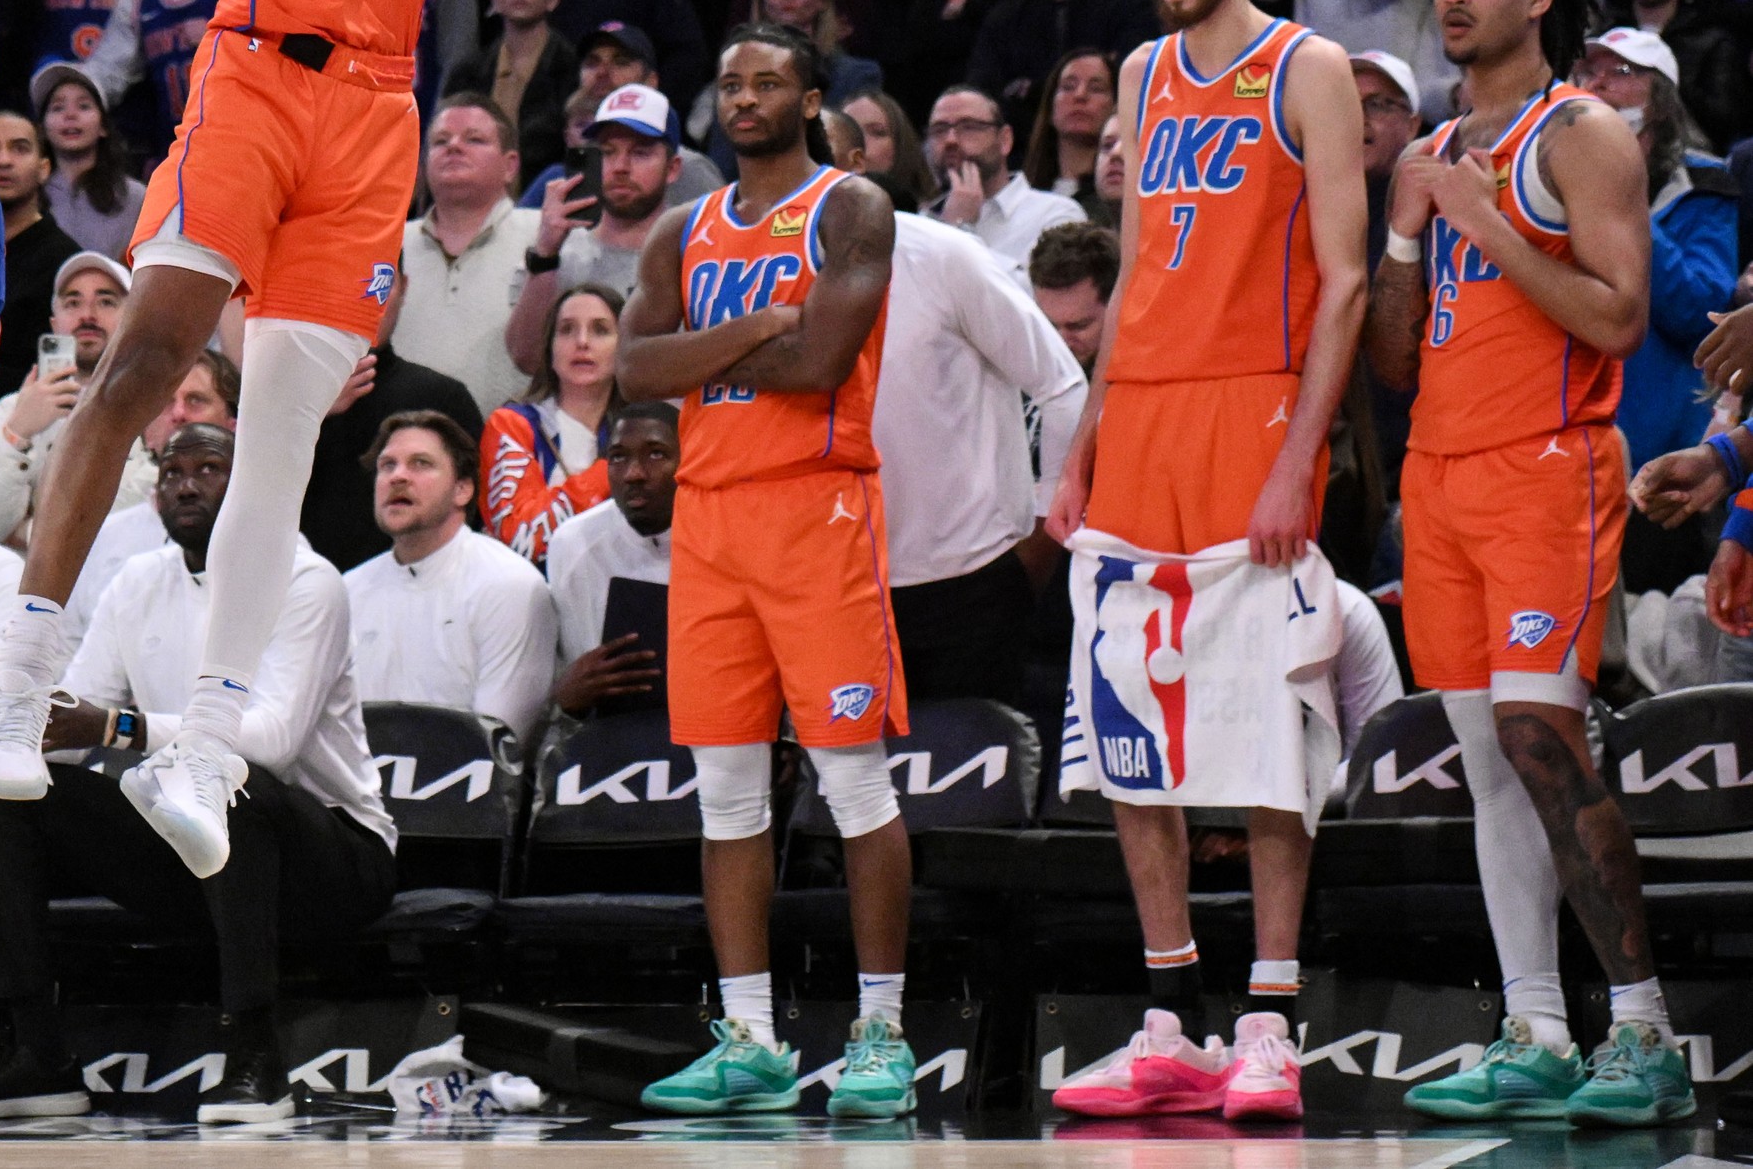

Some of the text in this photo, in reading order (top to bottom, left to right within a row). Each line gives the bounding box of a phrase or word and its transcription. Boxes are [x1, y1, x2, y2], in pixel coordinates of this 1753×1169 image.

[1137, 114, 1263, 198] OKC
[1165, 202, 1196, 270] 7
[689, 252, 801, 332] OKC
[1430, 282, 1458, 348] 6
[1102, 736, 1151, 778] NBA
